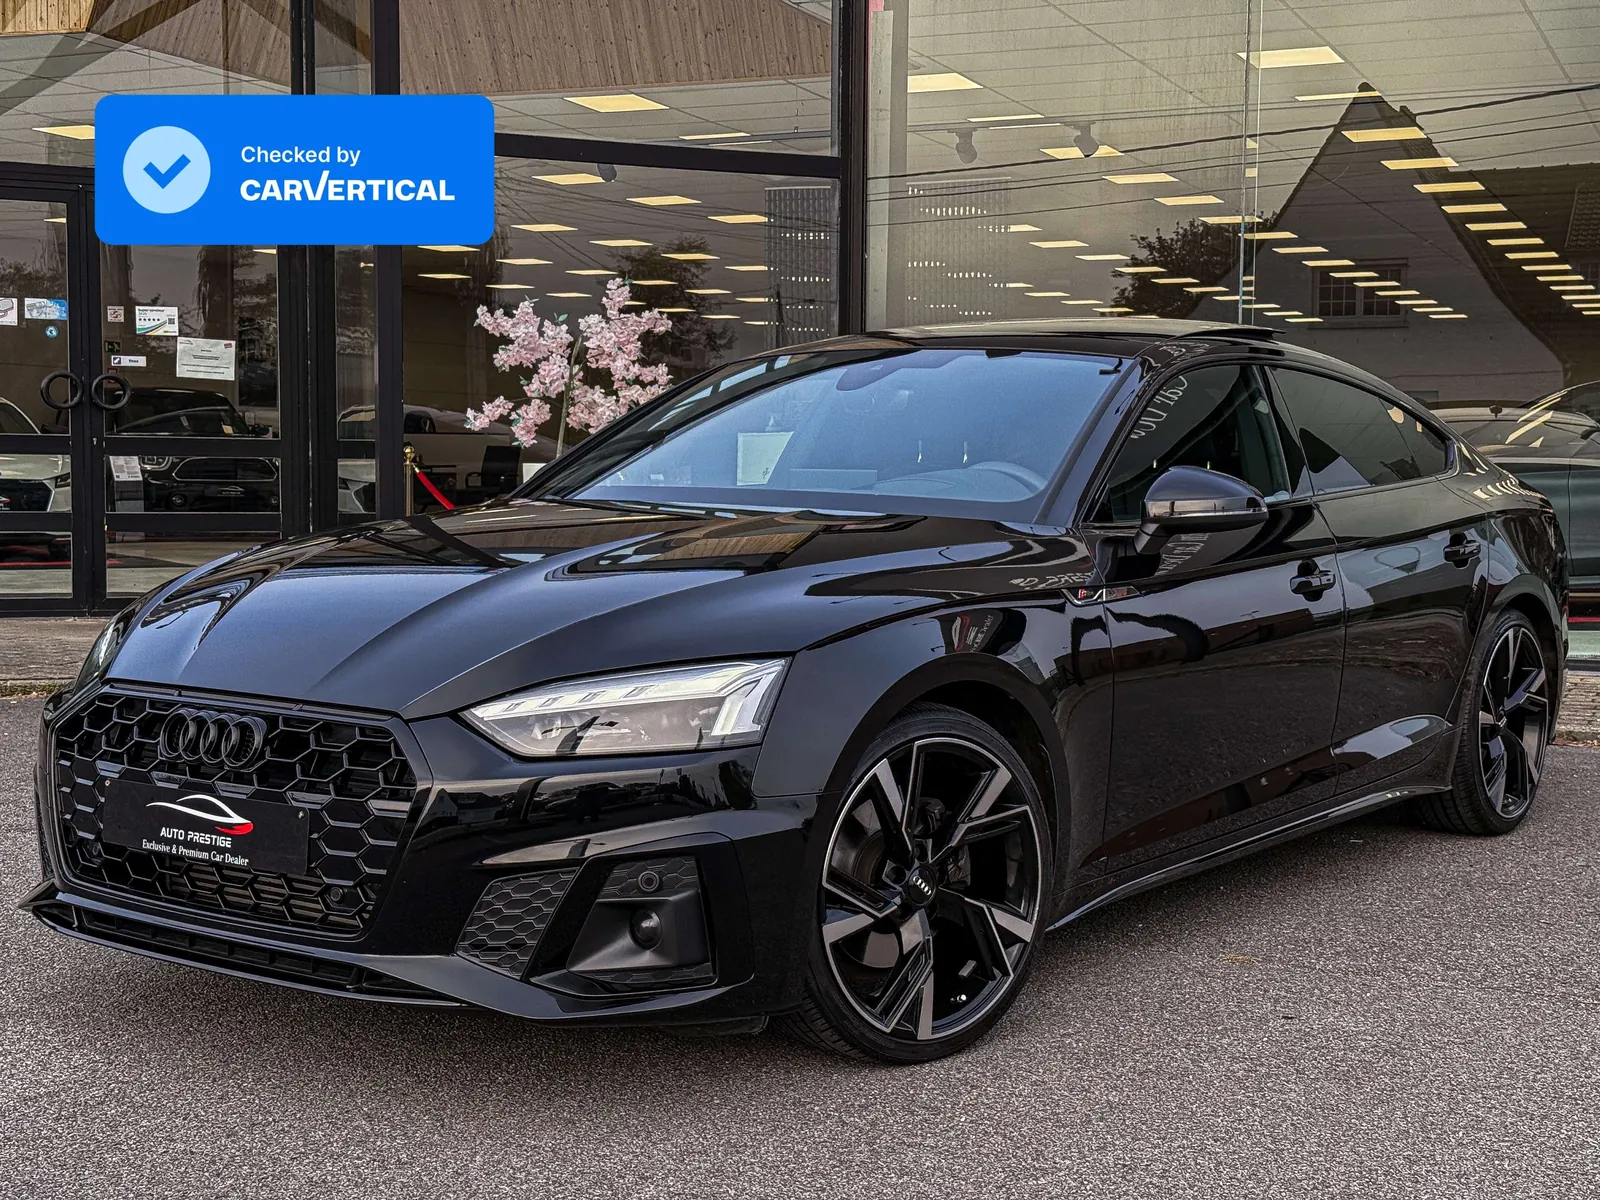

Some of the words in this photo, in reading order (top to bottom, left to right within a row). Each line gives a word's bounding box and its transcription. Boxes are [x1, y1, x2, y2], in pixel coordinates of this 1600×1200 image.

[160, 827, 185, 840] AUTO
[187, 831, 232, 848] PRESTIGE
[142, 839, 171, 853] Exclusive
[171, 844, 177, 854] &
[178, 845, 209, 860] Premium
[210, 851, 224, 862] Car
[225, 853, 249, 866] Dealer
